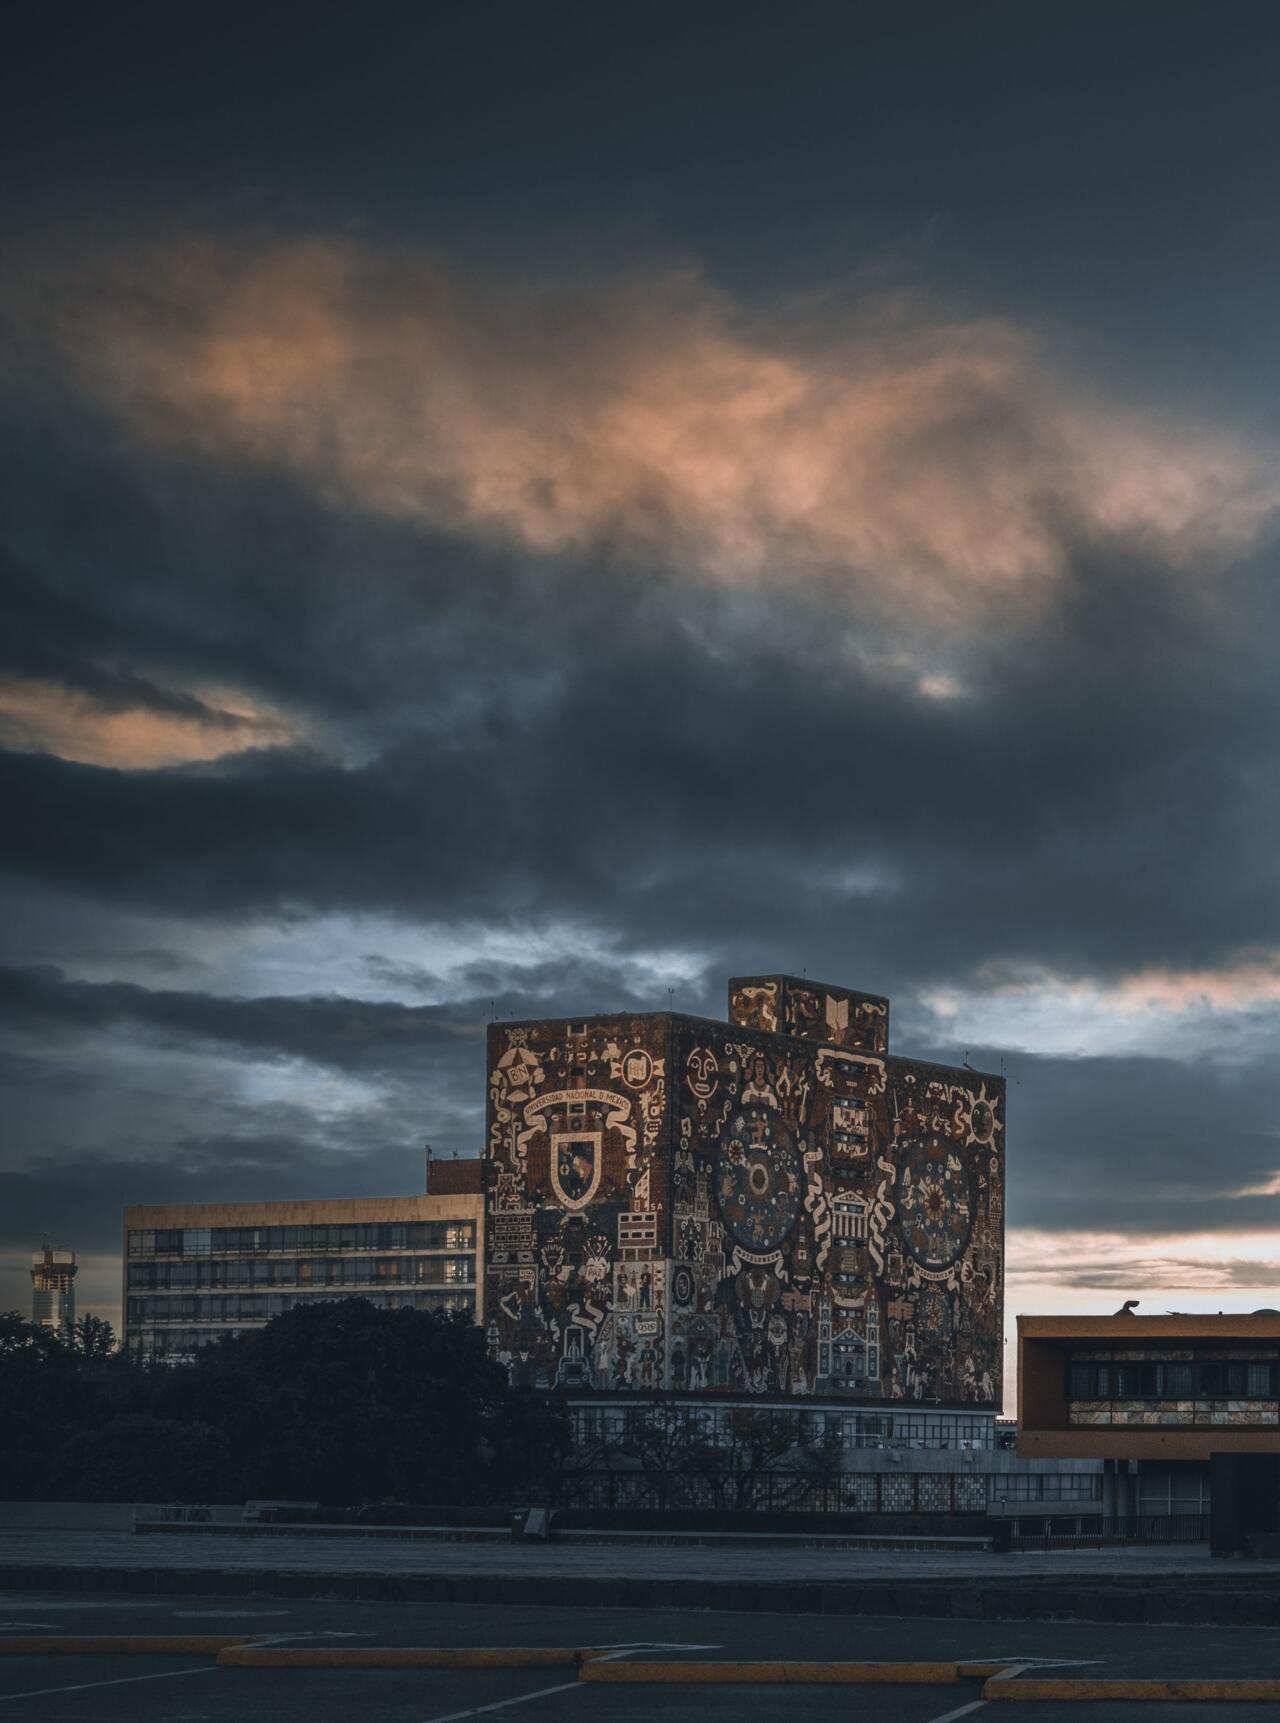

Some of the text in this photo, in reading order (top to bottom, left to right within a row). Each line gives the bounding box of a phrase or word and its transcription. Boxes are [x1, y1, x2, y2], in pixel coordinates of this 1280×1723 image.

[511, 1065, 527, 1081] BN
[566, 1091, 597, 1100] NACIONAL
[605, 1093, 629, 1110] MEXICO
